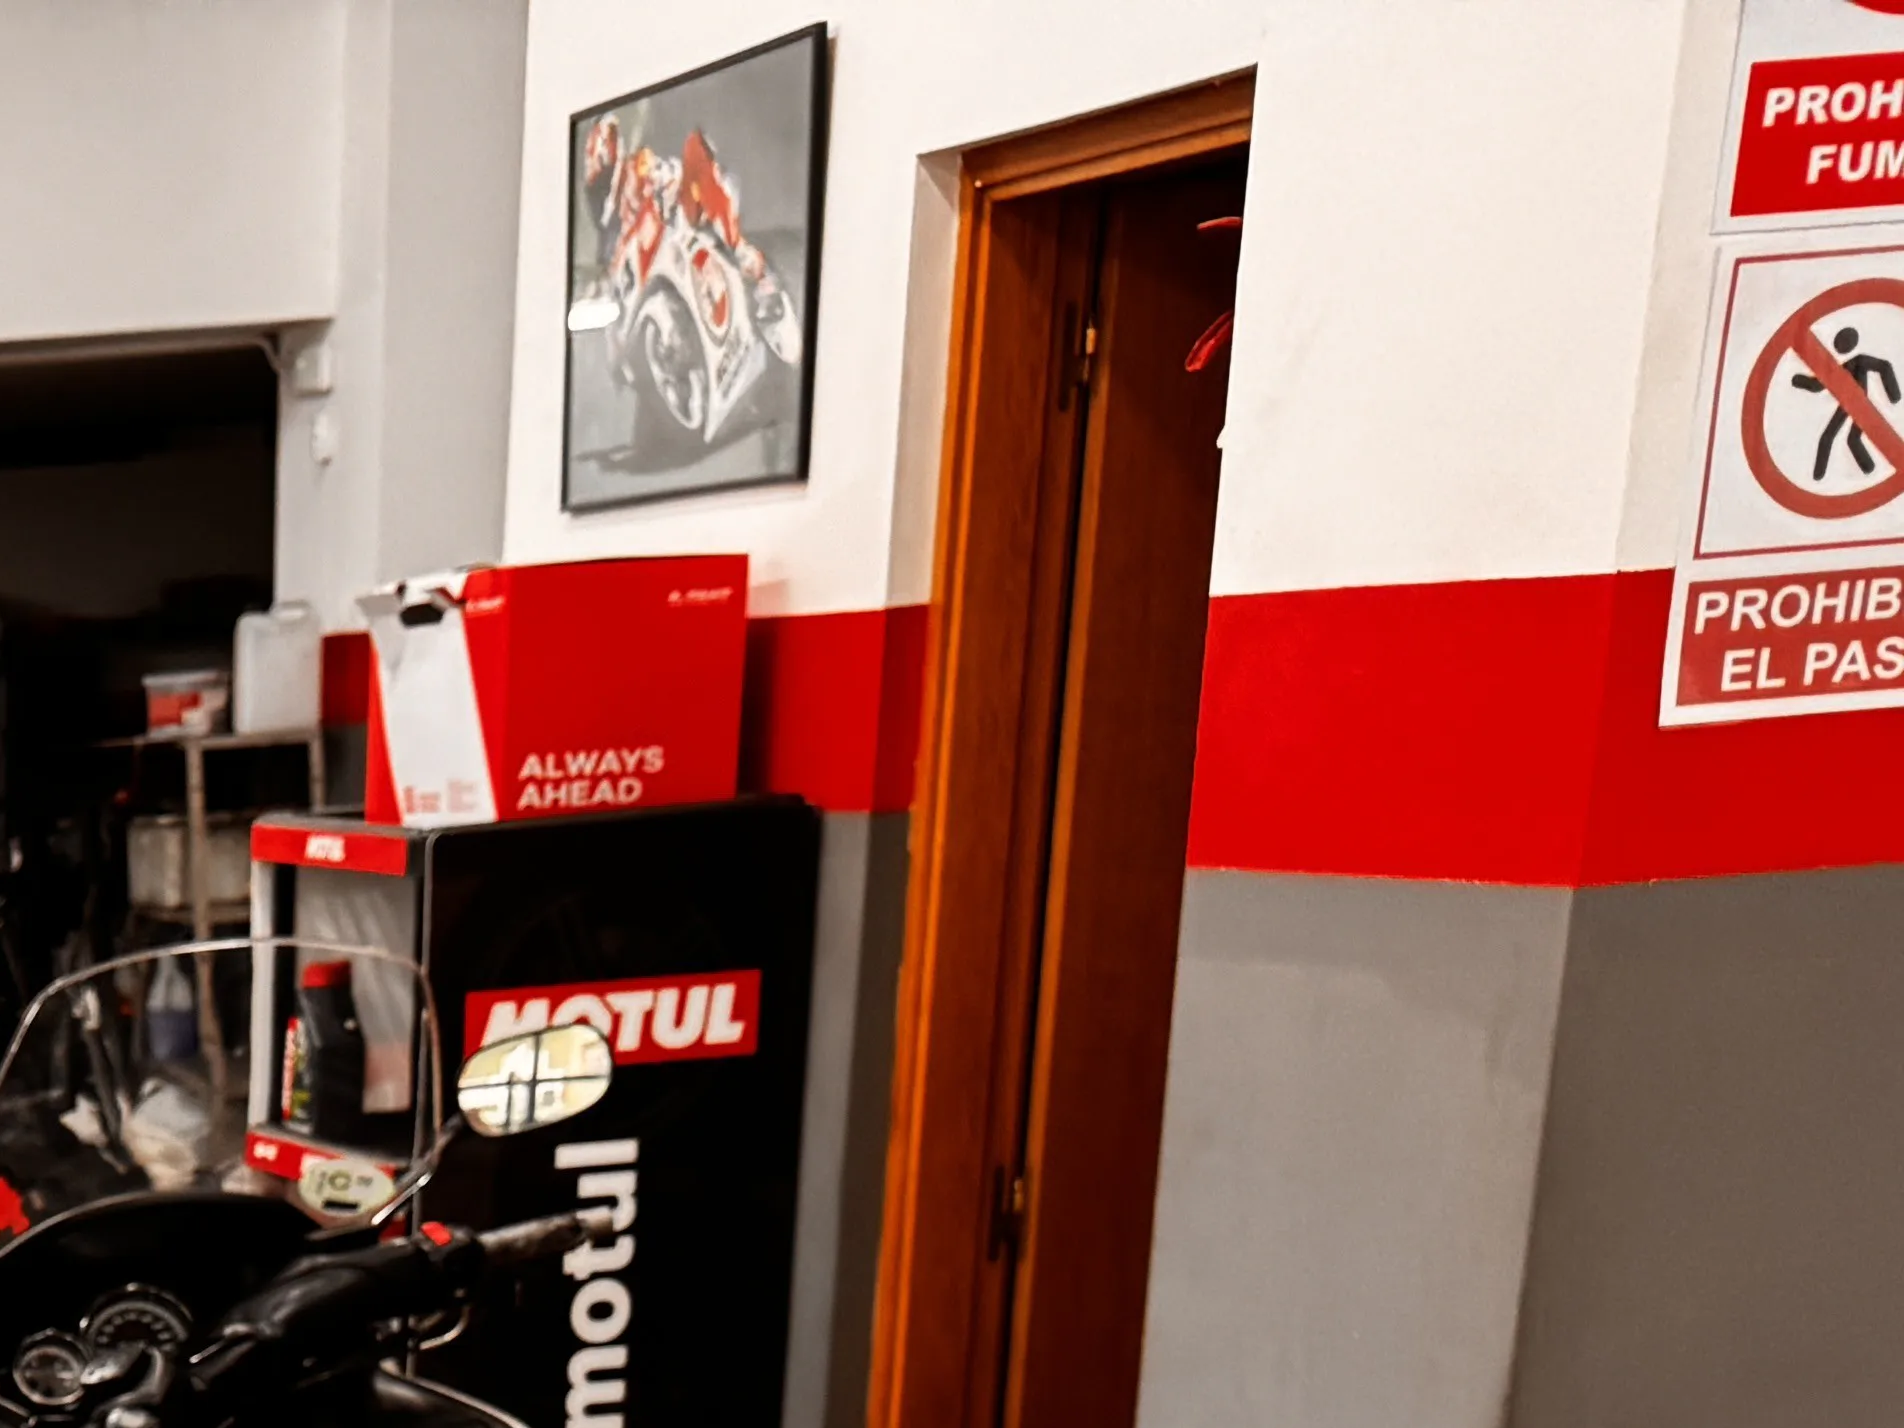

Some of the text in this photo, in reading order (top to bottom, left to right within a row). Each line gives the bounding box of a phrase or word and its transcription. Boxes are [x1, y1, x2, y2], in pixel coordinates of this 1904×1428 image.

[1762, 78, 1904, 128] PROH
[1694, 577, 1903, 635] PROHIB
[1720, 636, 1904, 692] EL PAS
[517, 745, 665, 781] ALWAYS
[516, 776, 644, 811] AHEAD
